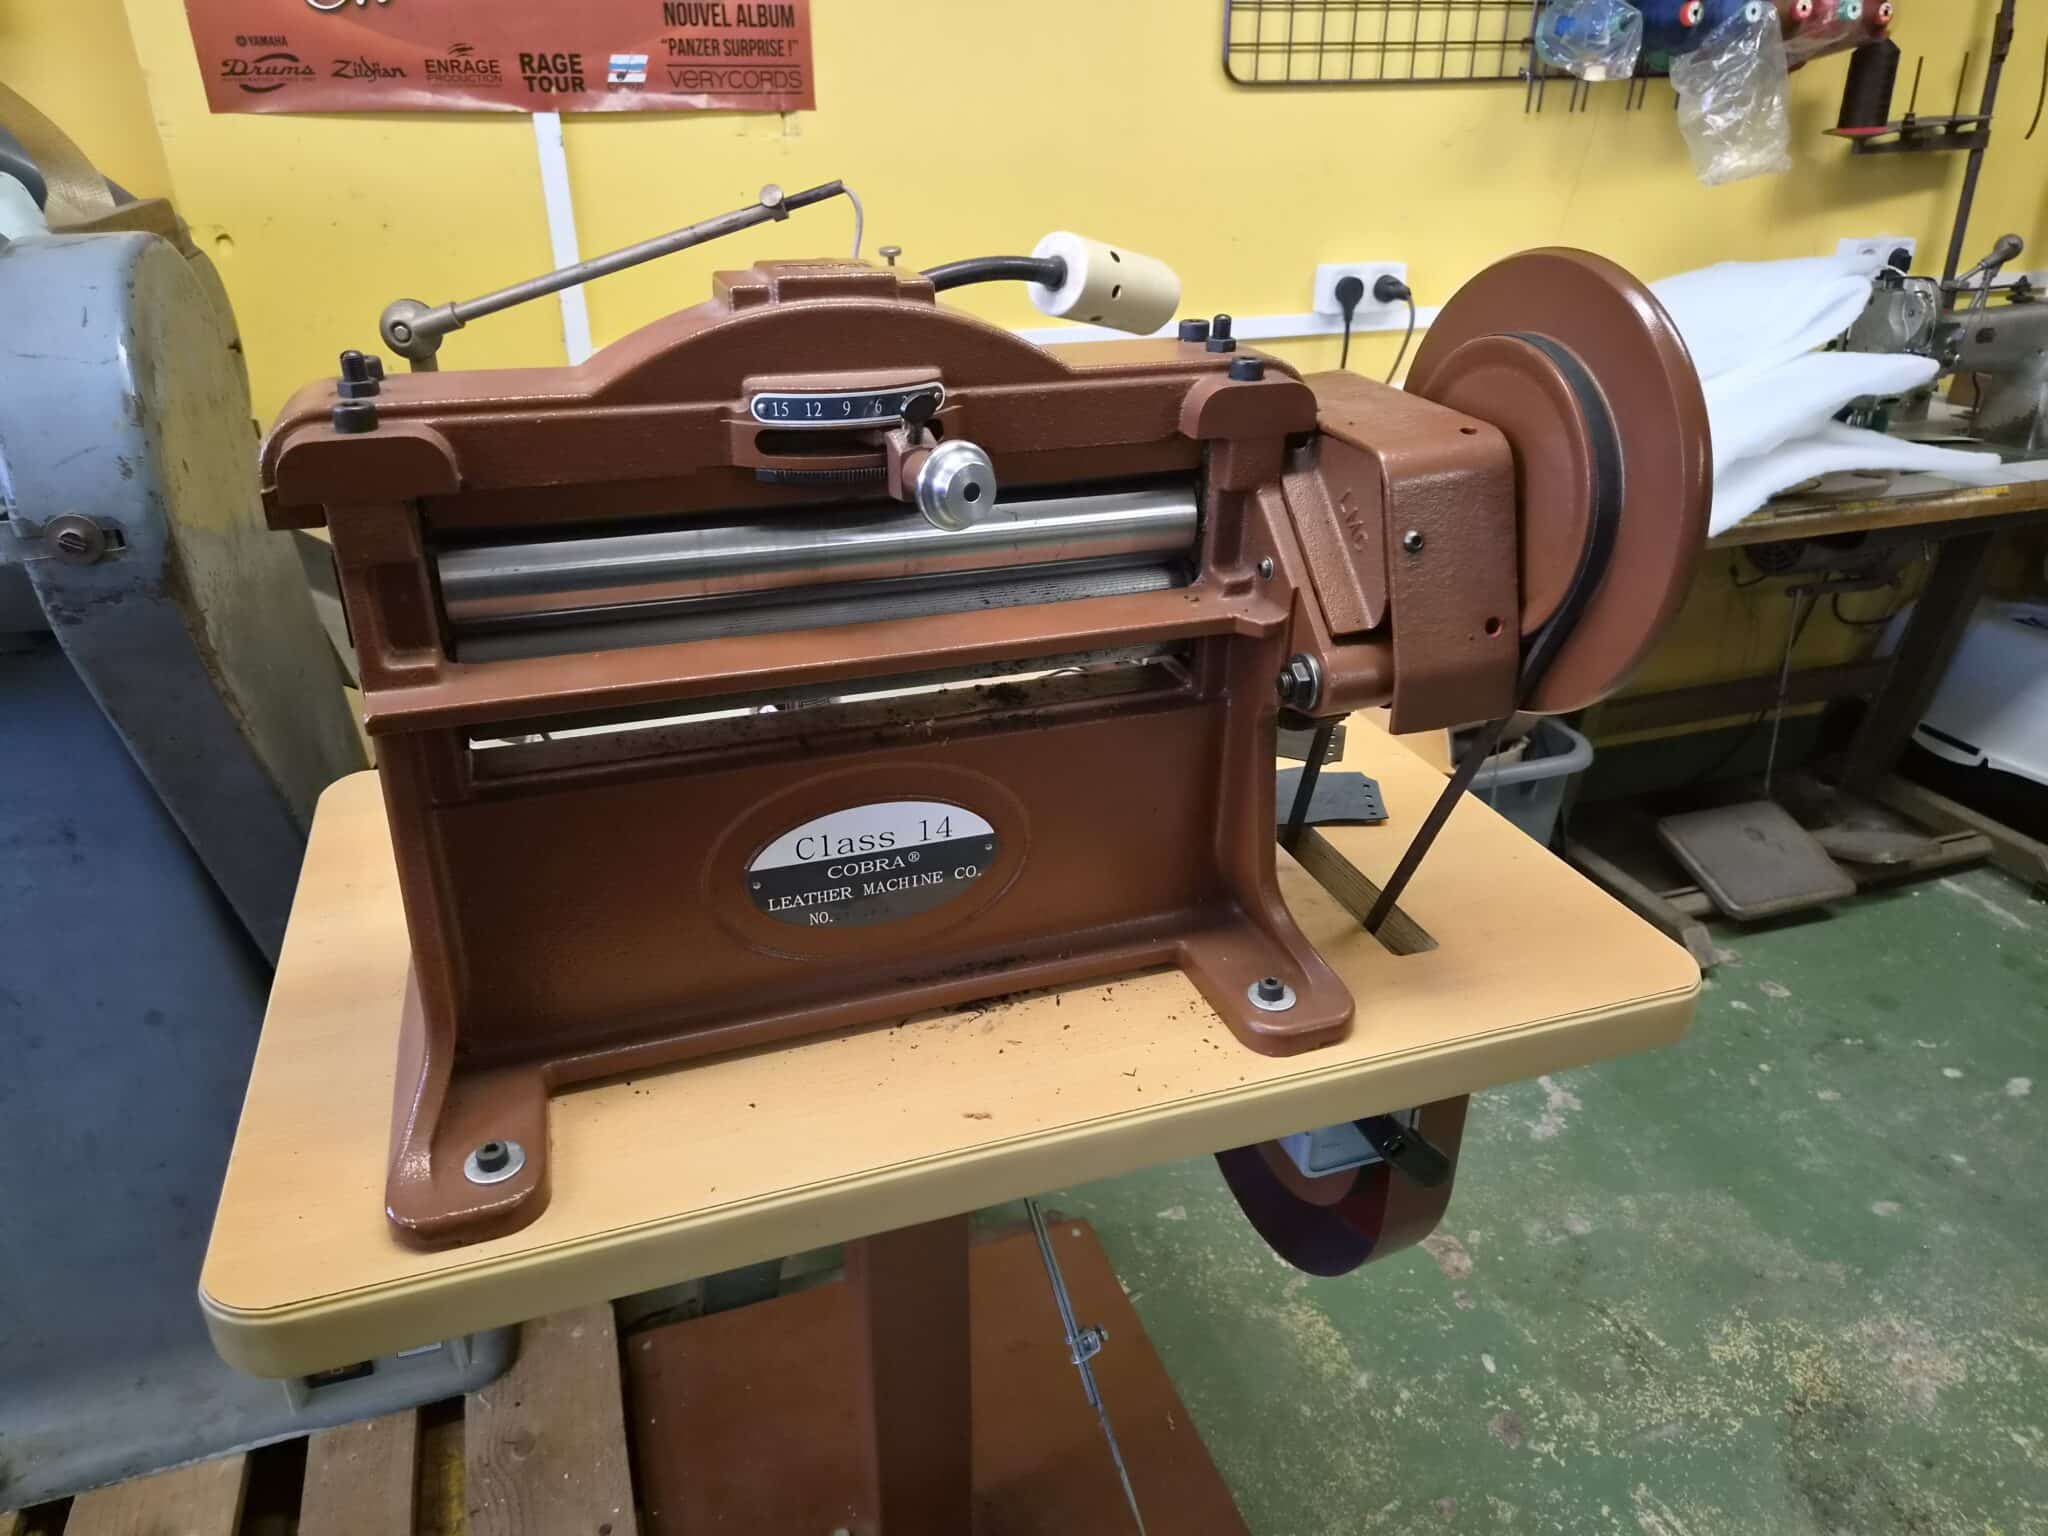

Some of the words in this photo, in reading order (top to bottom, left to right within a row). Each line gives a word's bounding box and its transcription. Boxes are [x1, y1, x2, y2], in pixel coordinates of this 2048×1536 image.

[664, 3, 731, 28] NOUVEL
[737, 4, 795, 28] ALBUM
[248, 35, 288, 47] YAMAHA
[723, 40, 785, 57] SURPRISE
[221, 58, 316, 77] Drums
[331, 56, 407, 82] Zildjian
[424, 59, 501, 74] ENRAGE
[519, 53, 583, 74] RAGE
[426, 74, 503, 82] PRODUCTION
[523, 76, 585, 93] TOUR
[773, 402, 789, 417] 15
[805, 401, 823, 417] 12
[842, 401, 851, 416] 9
[874, 399, 883, 414] 6
[795, 831, 896, 861] Class
[918, 815, 953, 842] 14
[767, 886, 853, 912] LEATHER
[863, 871, 943, 897] MACHINE
[954, 865, 982, 880] CO.
[809, 911, 833, 926] NO.
